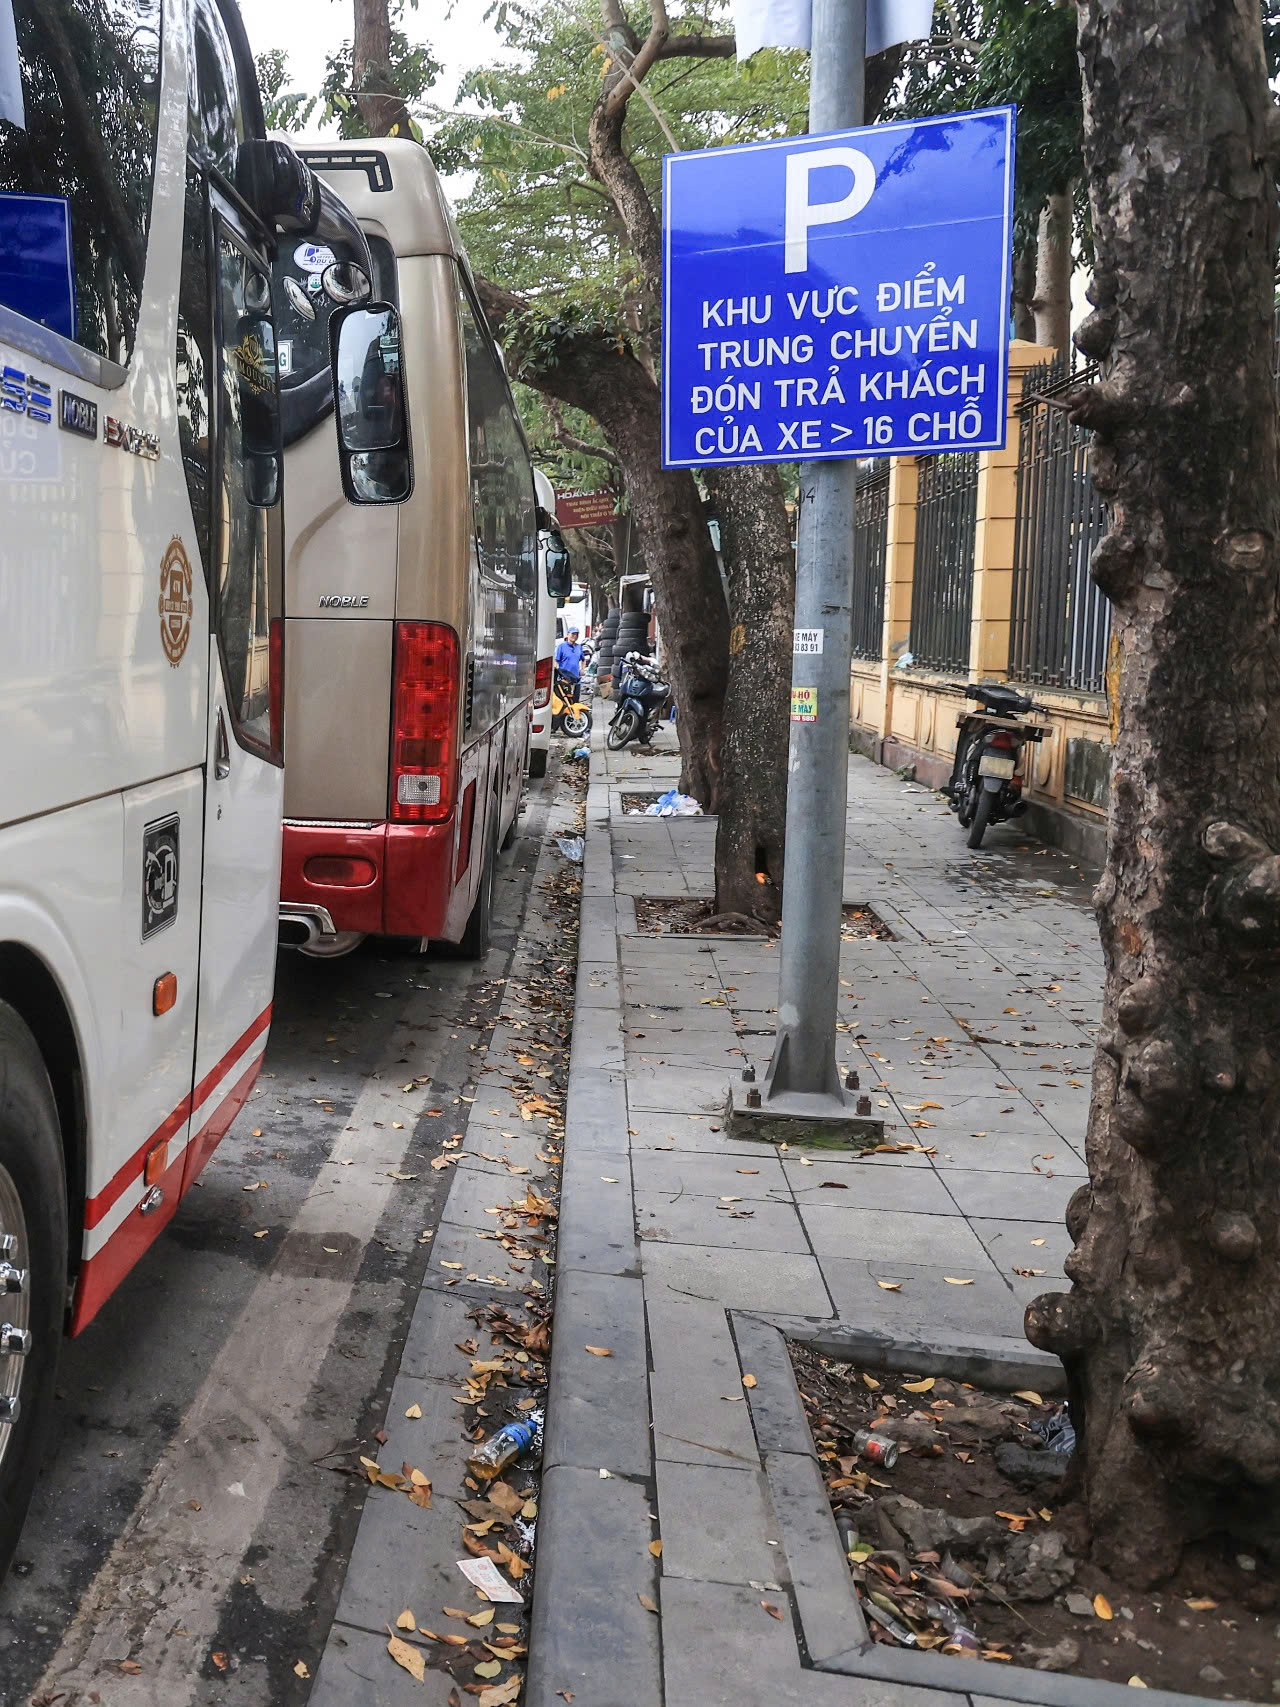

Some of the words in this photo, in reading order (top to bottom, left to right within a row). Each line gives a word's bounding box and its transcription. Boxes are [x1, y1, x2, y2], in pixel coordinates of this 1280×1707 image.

[784, 146, 877, 274] P
[701, 295, 772, 329] KHU
[786, 284, 859, 324] VỰC
[876, 261, 966, 313] ĐIỂM
[697, 334, 814, 371] TRUNG
[830, 305, 978, 360] CHUYỂN
[690, 376, 761, 414] ĐÓN
[774, 365, 846, 408] TRẢ
[859, 360, 986, 402] KHÁCH
[694, 415, 763, 455] CỦA
[776, 419, 822, 451] XE
[830, 422, 853, 444] >
[863, 415, 893, 446] 16
[907, 395, 983, 442] CHỖ
[318, 595, 370, 608] NOBLE
